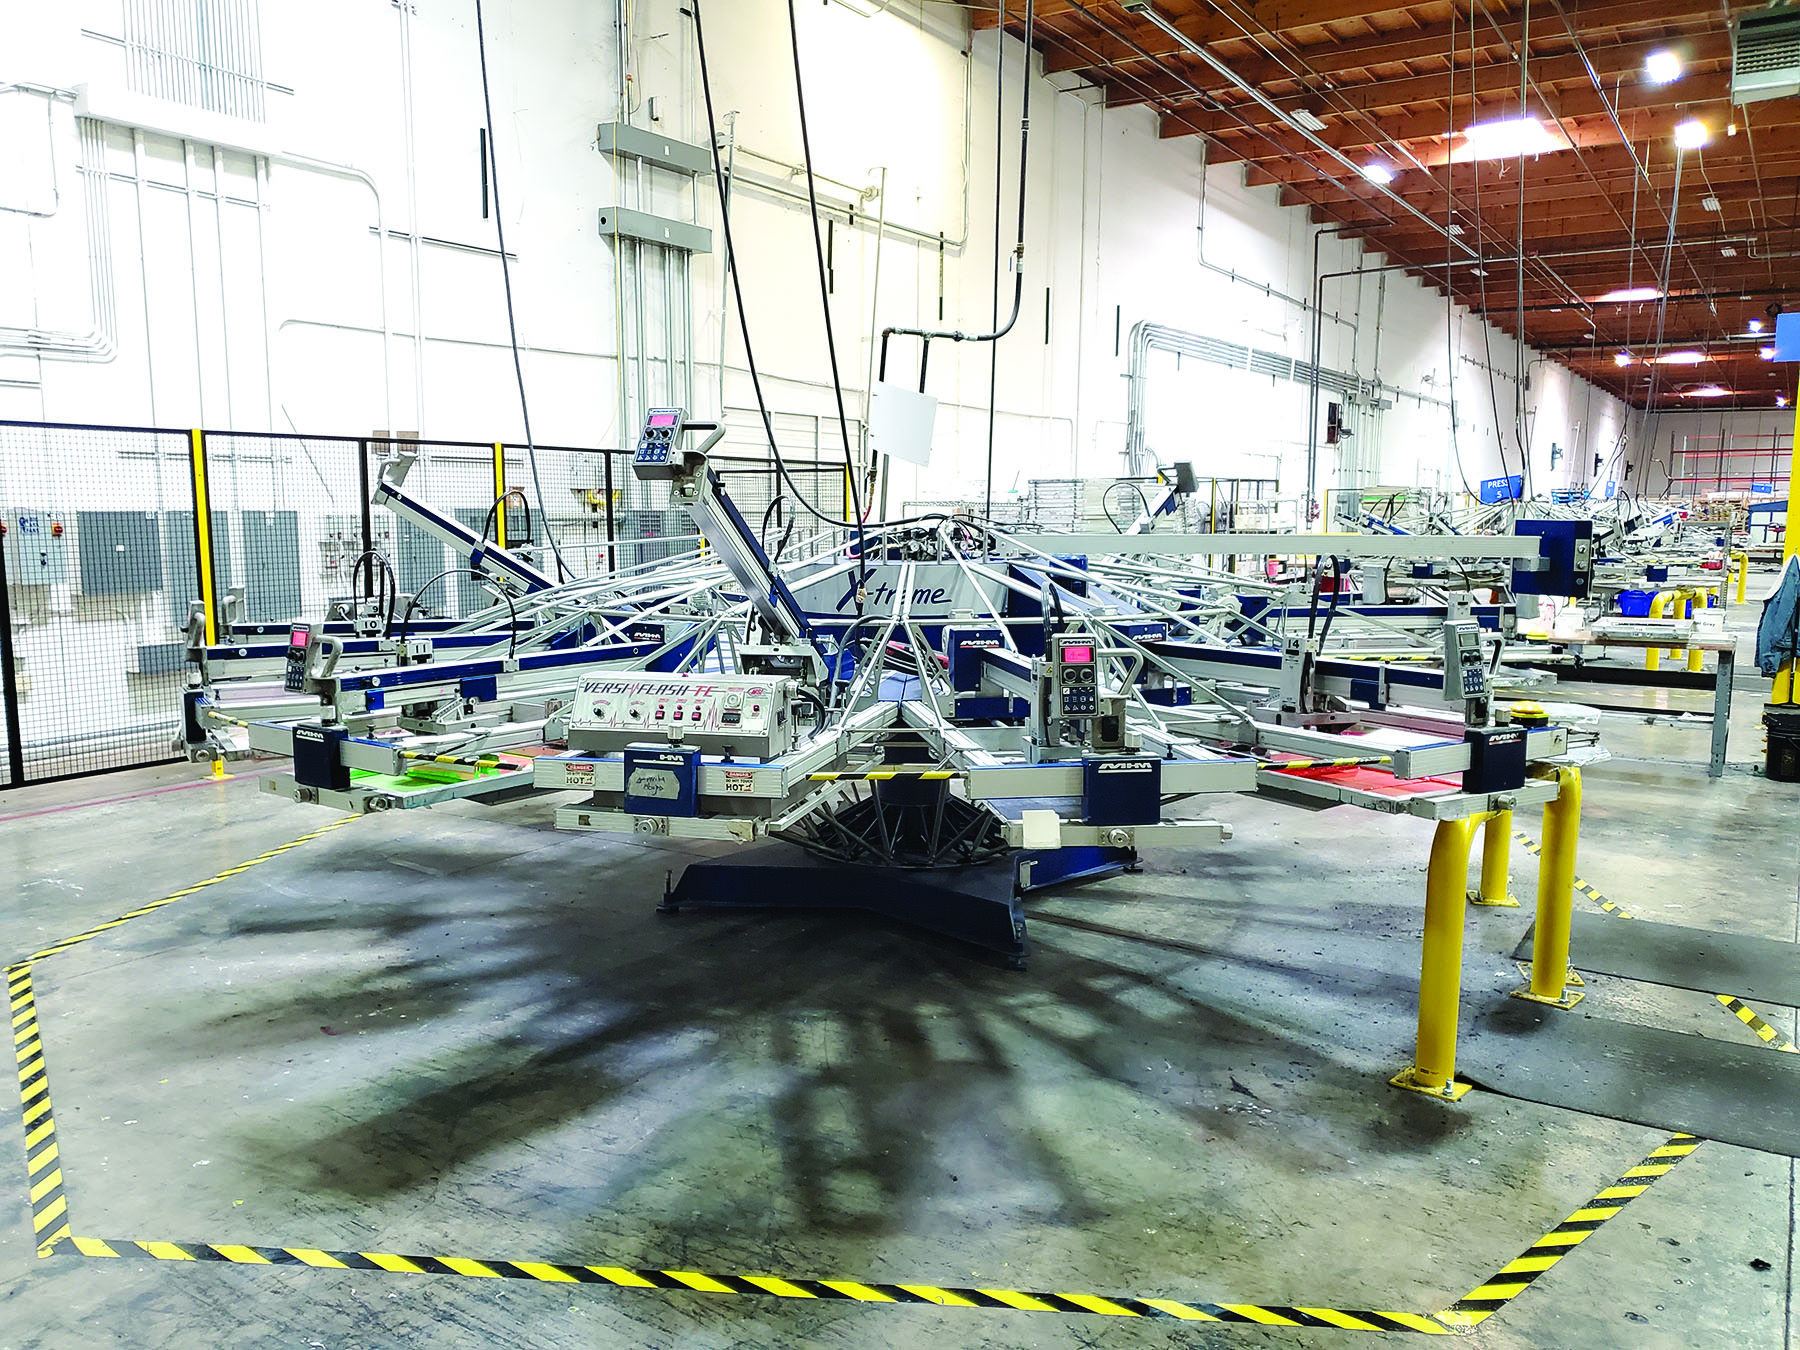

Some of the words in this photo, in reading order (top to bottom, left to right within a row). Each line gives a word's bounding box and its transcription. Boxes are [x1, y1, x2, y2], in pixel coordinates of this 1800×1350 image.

[1487, 479, 1508, 489] PRESS
[372, 605, 379, 613] 9
[364, 620, 378, 629] 10
[415, 643, 426, 654] 11
[1287, 639, 1300, 649] 14
[726, 783, 745, 791] HOT
